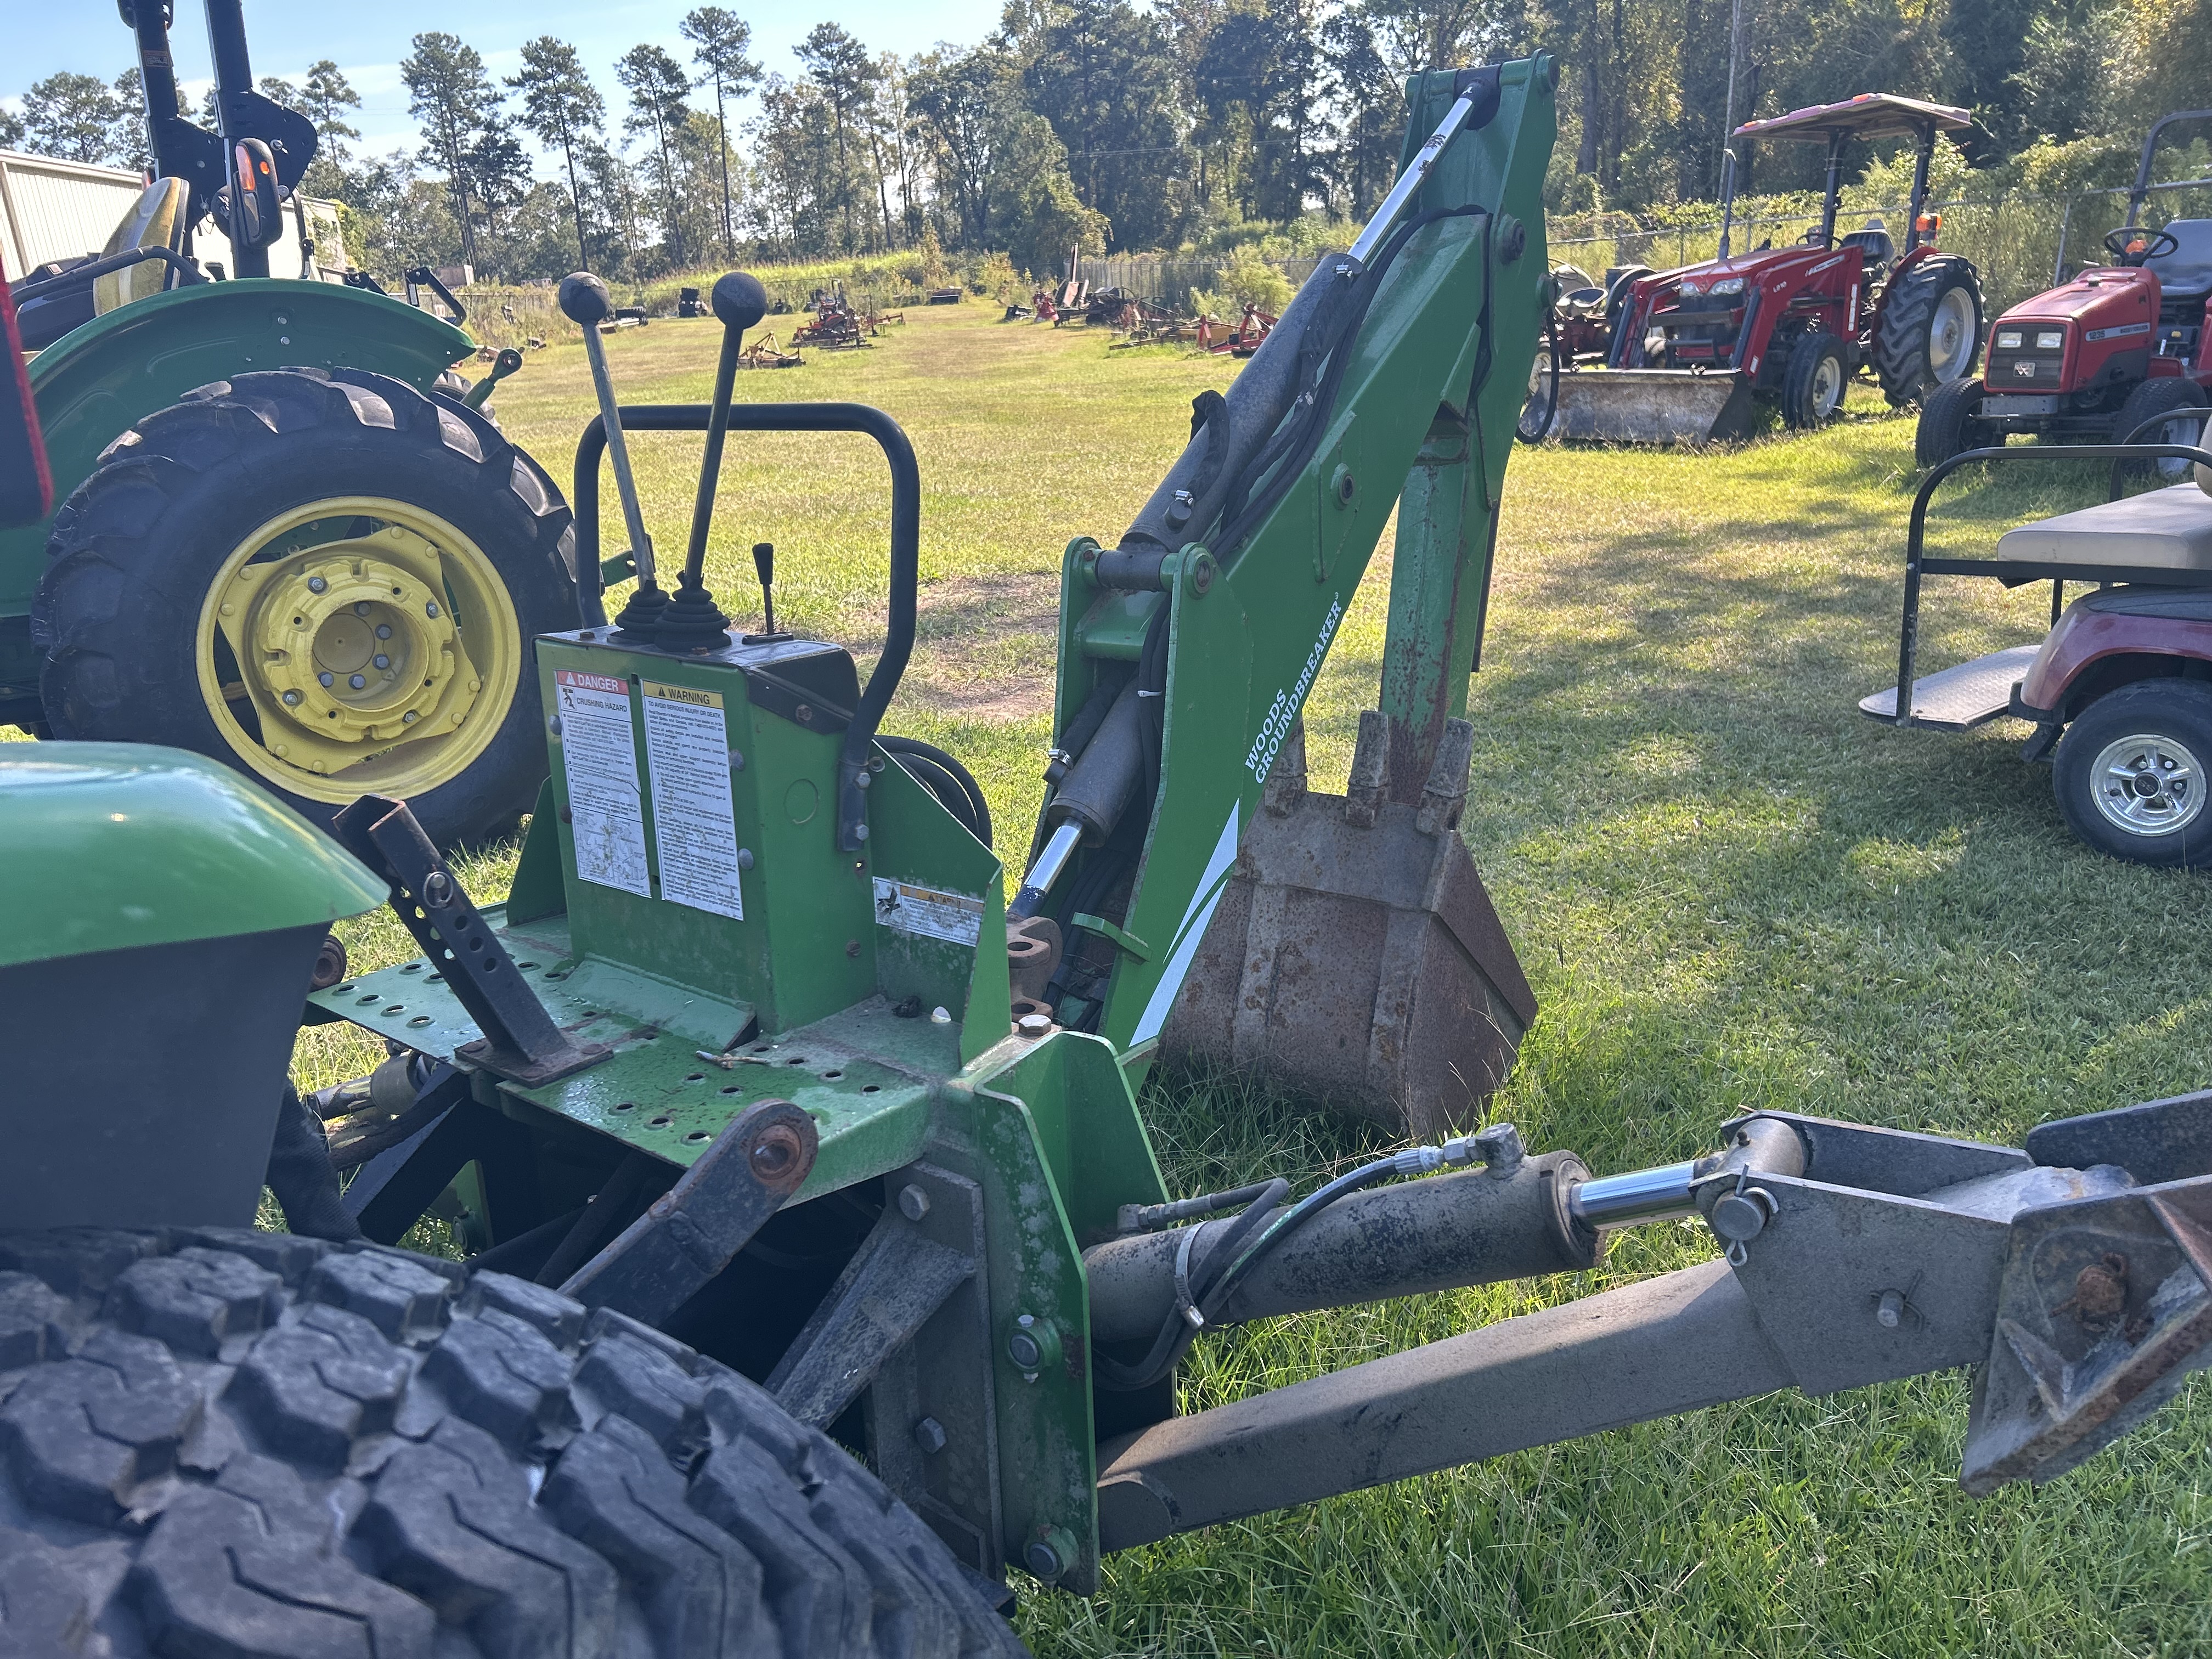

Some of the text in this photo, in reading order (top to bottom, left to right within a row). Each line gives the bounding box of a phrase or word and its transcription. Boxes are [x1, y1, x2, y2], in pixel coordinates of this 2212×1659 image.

[2089, 330, 2106, 340] 1235
[577, 674, 619, 692] DANGER
[577, 697, 628, 712] CRUSHING HAZARD
[668, 688, 710, 705] WARNING
[1245, 689, 1286, 770] WOODS
